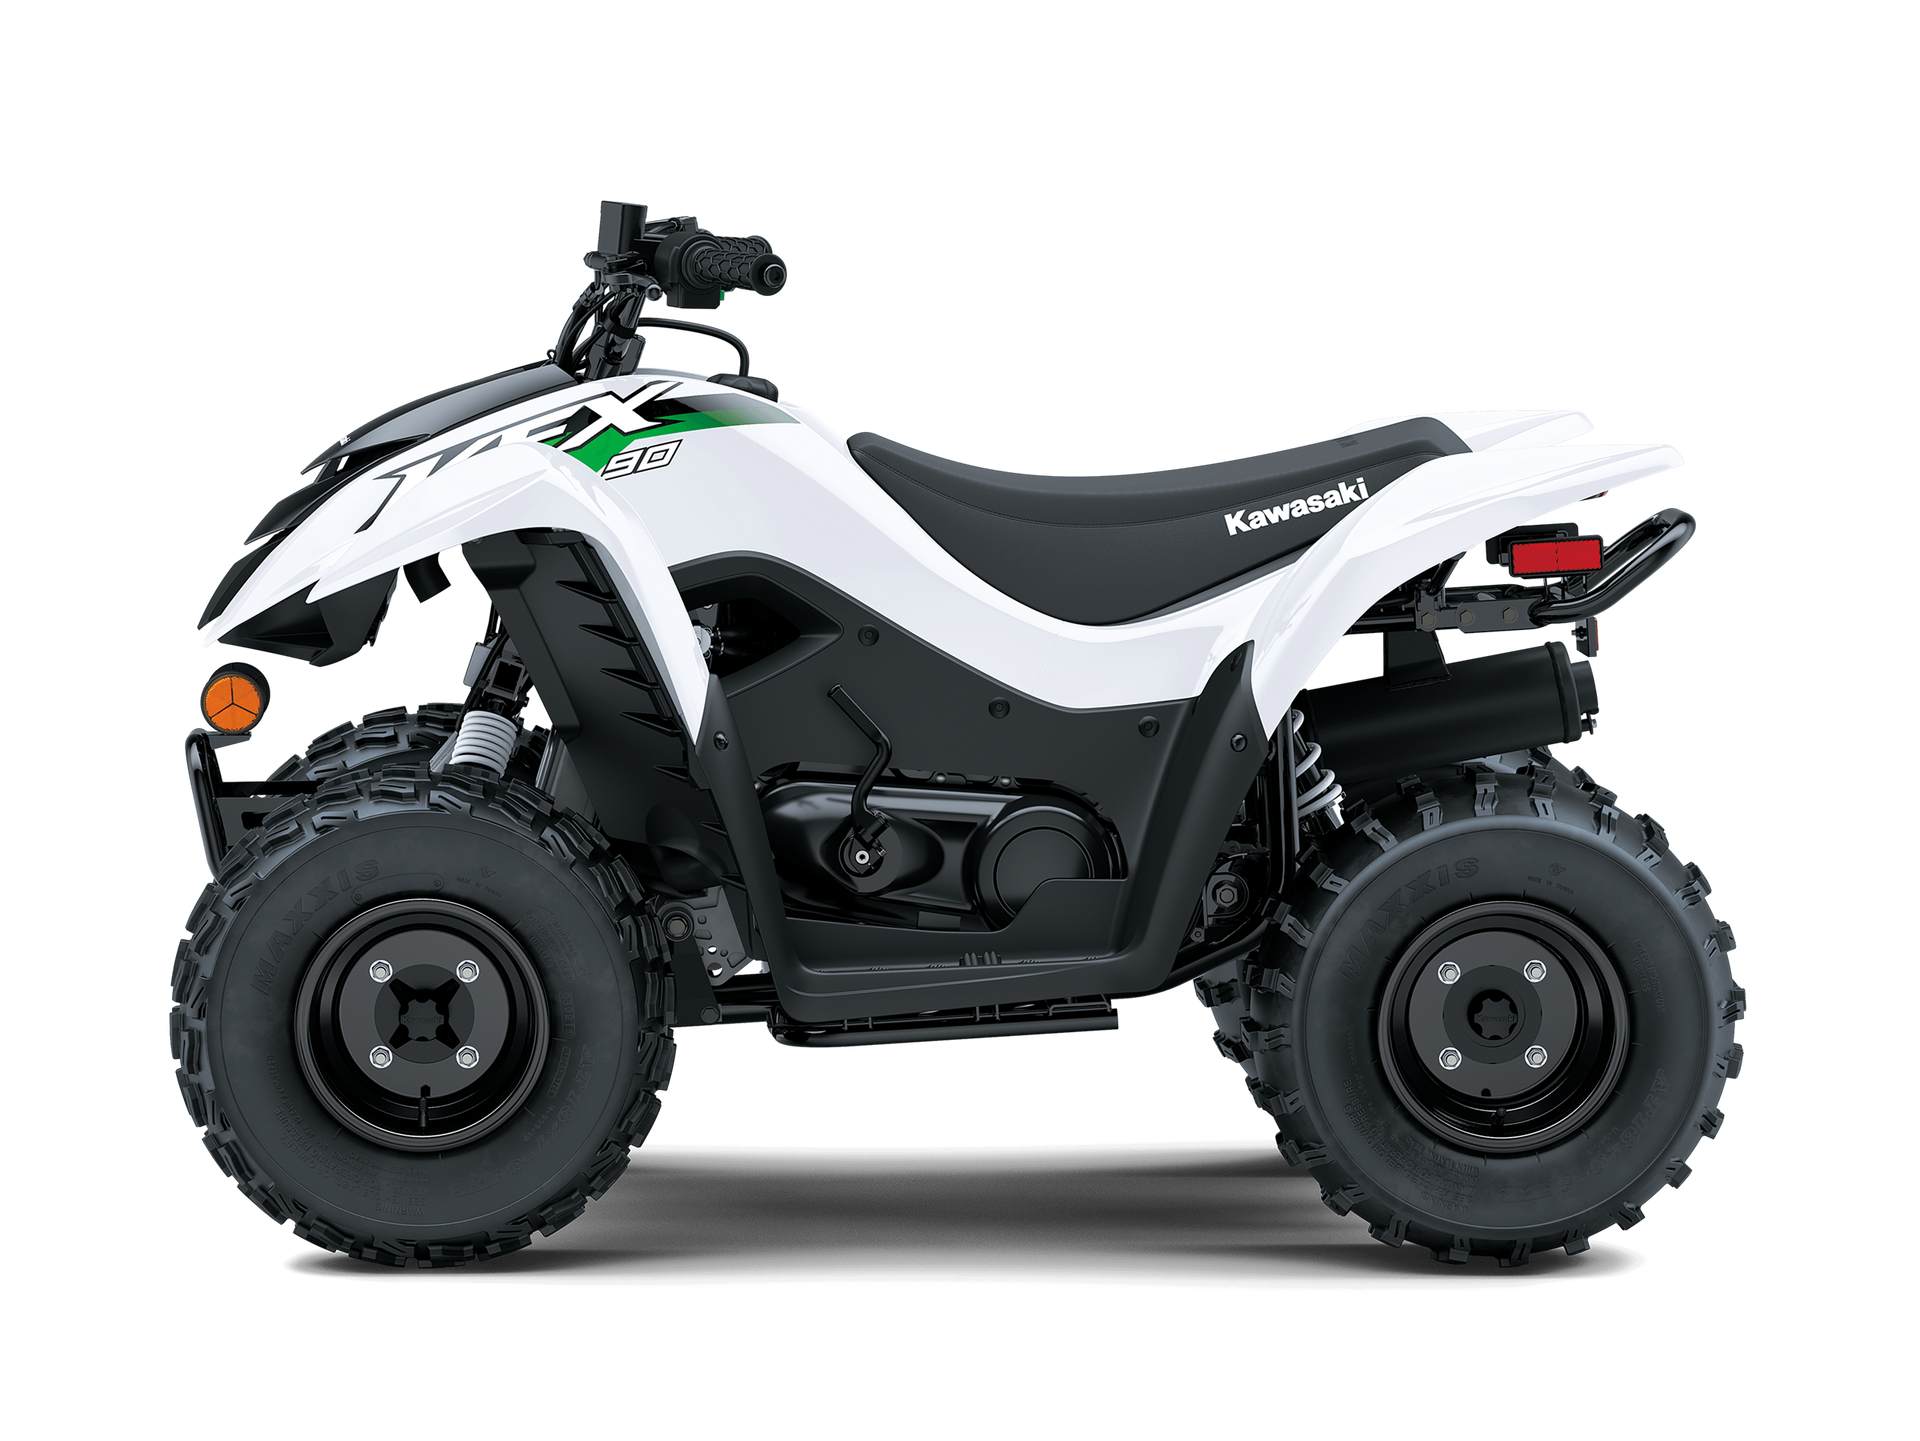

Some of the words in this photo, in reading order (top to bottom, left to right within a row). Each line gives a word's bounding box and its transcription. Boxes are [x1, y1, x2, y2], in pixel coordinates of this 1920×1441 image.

[600, 438, 684, 481] 90
[1224, 476, 1370, 537] Kawasaki
[250, 859, 379, 996] MAXXIS
[1338, 857, 1480, 985] MAXXIS
[553, 921, 575, 953] ROTATION
[529, 933, 554, 969] TUBELESS
[1631, 956, 1652, 994] TUBELESS
[402, 1015, 443, 1024] Kawasaki
[1342, 1077, 1373, 1126] PRESSURE.
[273, 1105, 313, 1150] PRESSURE.
[1343, 1104, 1374, 1144] OWNER'S
[1371, 1127, 1415, 1168] OPERATING
[1373, 1144, 1387, 1158] OR
[1392, 1133, 1418, 1156] BEYOND
[1407, 1136, 1426, 1152] BEAD
[312, 1149, 362, 1182] OPERATING
[334, 1151, 363, 1170] BEYOND
[350, 1151, 370, 1164] BEAD
[372, 1160, 403, 1173] SEATING
[1386, 1156, 1412, 1178] LABEL
[1419, 1154, 1447, 1173] INFLATE
[1427, 1148, 1456, 1168] SEATING
[318, 1166, 332, 1179] OR
[365, 1166, 396, 1180] INFLATE
[1415, 1164, 1434, 1180] FOR
[1450, 1169, 1465, 1179] NOT
[1459, 1163, 1479, 1175] WHEN
[333, 1175, 361, 1194] LABEL
[364, 1177, 383, 1190] FOR
[400, 1175, 414, 1183] NOT
[1414, 1176, 1452, 1198] VEHICLE
[1436, 1175, 1476, 1195] MANUAL
[365, 1189, 405, 1204] VEHICLE
[387, 1183, 427, 1195] MANUAL
[1455, 1193, 1474, 1204] SEE
[377, 1203, 424, 1216] WARNING
[410, 1197, 427, 1206] SEE
[1423, 1192, 1469, 1213] WARNING
